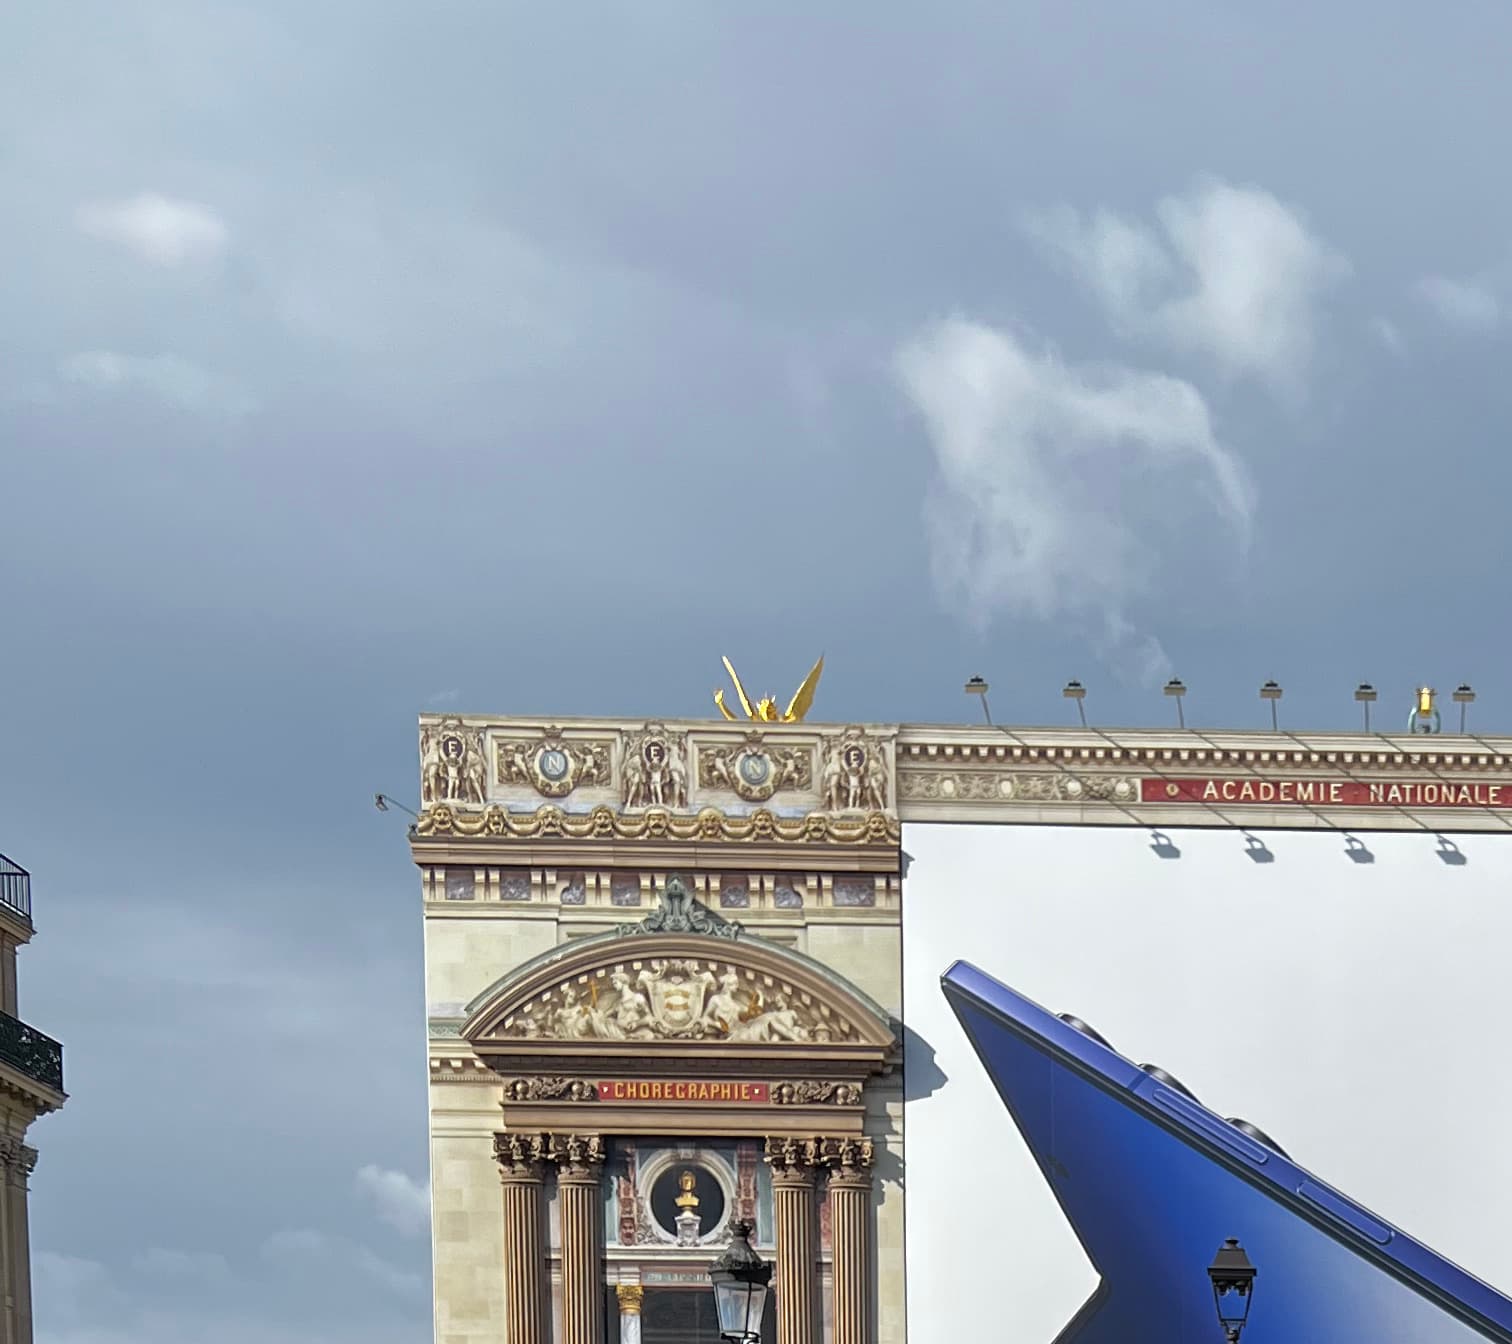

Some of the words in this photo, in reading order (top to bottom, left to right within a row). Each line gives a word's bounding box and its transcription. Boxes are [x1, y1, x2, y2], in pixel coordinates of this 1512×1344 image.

[1203, 780, 1344, 802] ACADEMIE
[1369, 783, 1501, 805] NATIONALE
[614, 1081, 751, 1099] CHOREGRAPHIE
